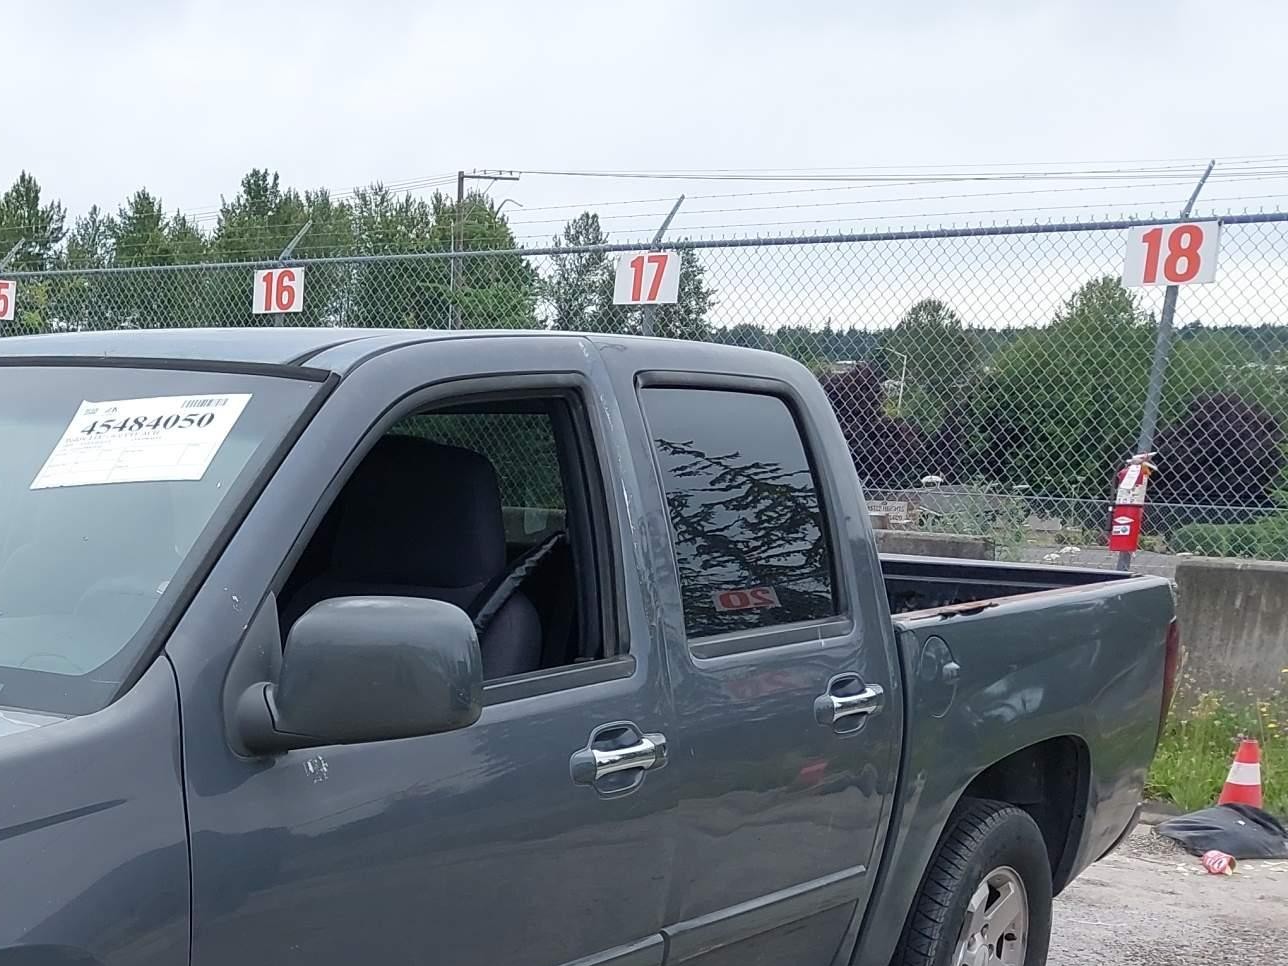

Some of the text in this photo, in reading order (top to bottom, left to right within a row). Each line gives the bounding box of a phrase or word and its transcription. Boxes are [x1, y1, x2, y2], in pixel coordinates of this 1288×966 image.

[1142, 224, 1204, 284] 18
[261, 268, 297, 313] 16
[630, 254, 669, 302] 17
[81, 412, 215, 436] 45484050
